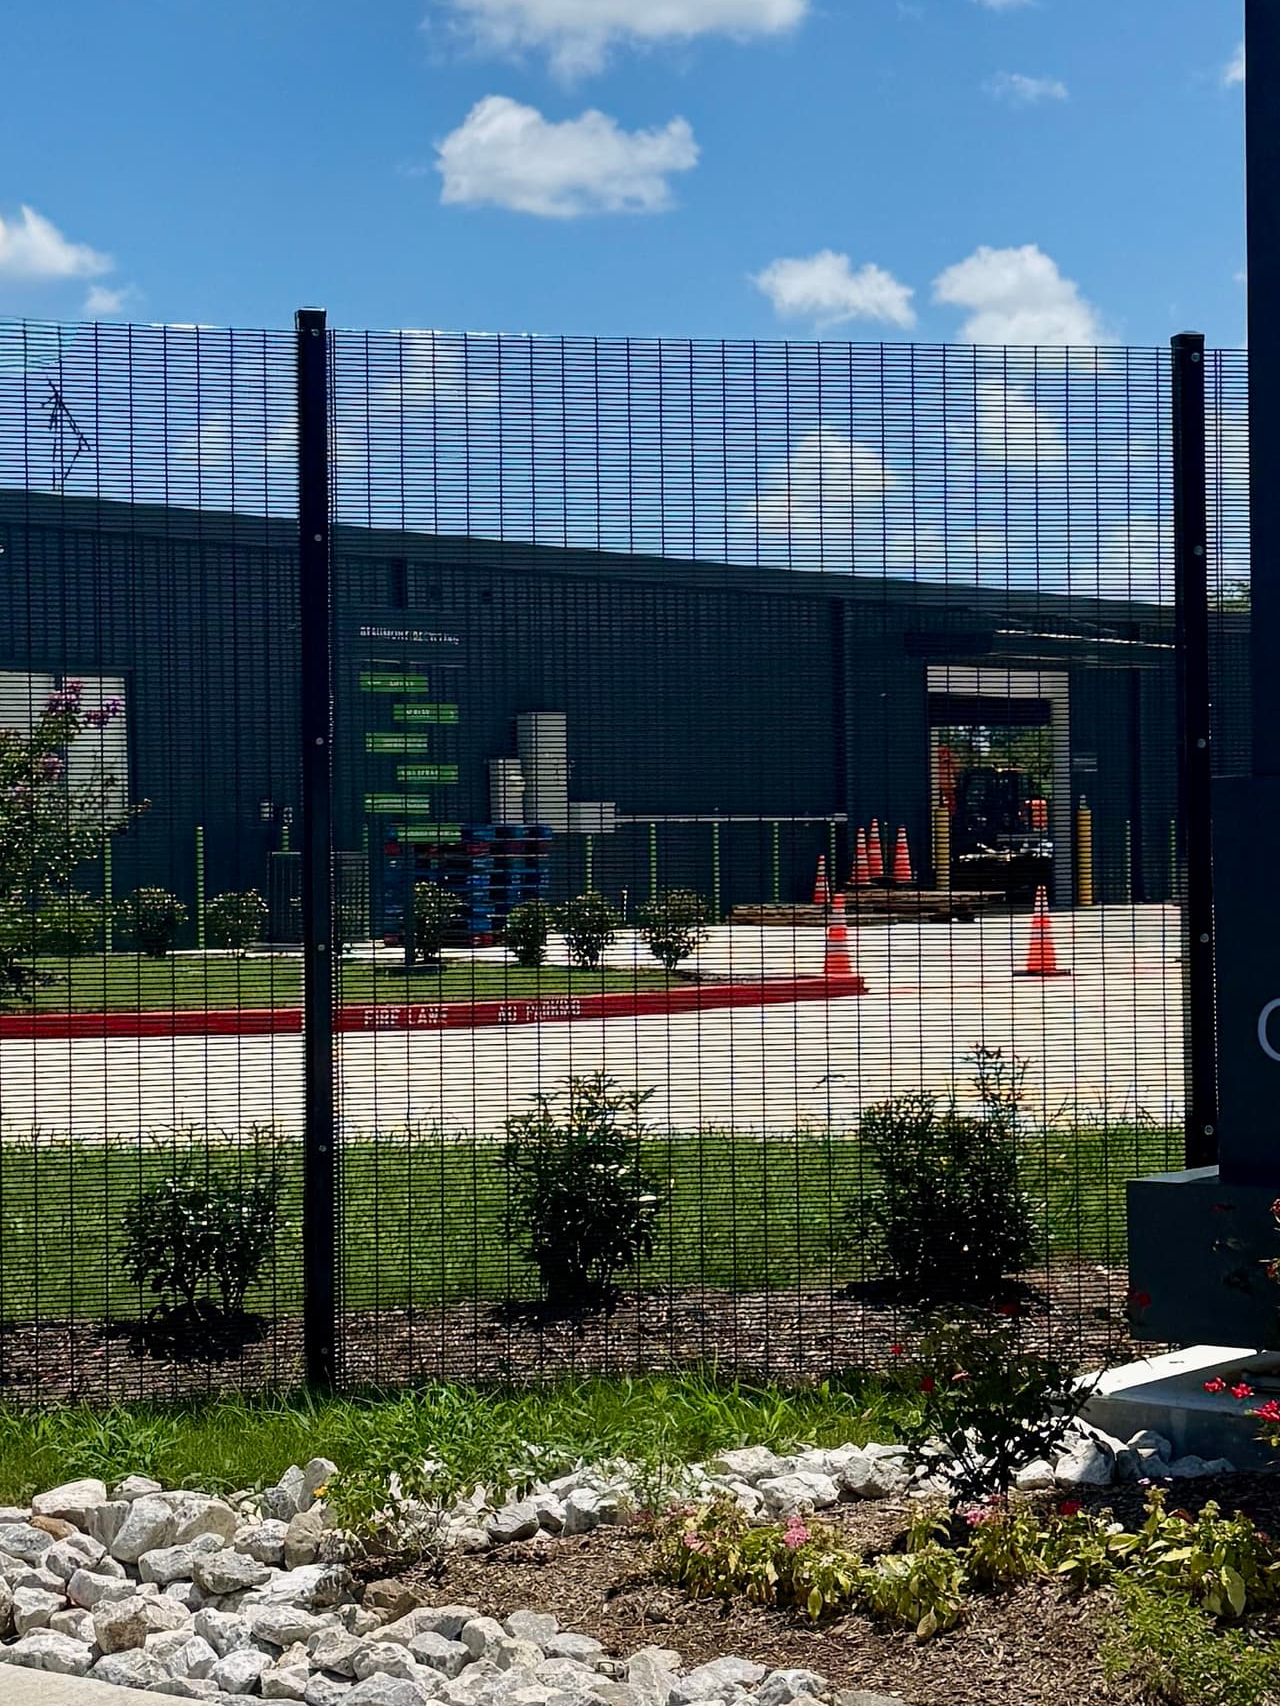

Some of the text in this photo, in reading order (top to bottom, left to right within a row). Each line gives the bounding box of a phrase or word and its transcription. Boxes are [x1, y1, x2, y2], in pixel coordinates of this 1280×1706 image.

[363, 1008, 401, 1026] FIRE
[407, 1007, 449, 1025] LANE
[497, 1004, 518, 1023] NO
